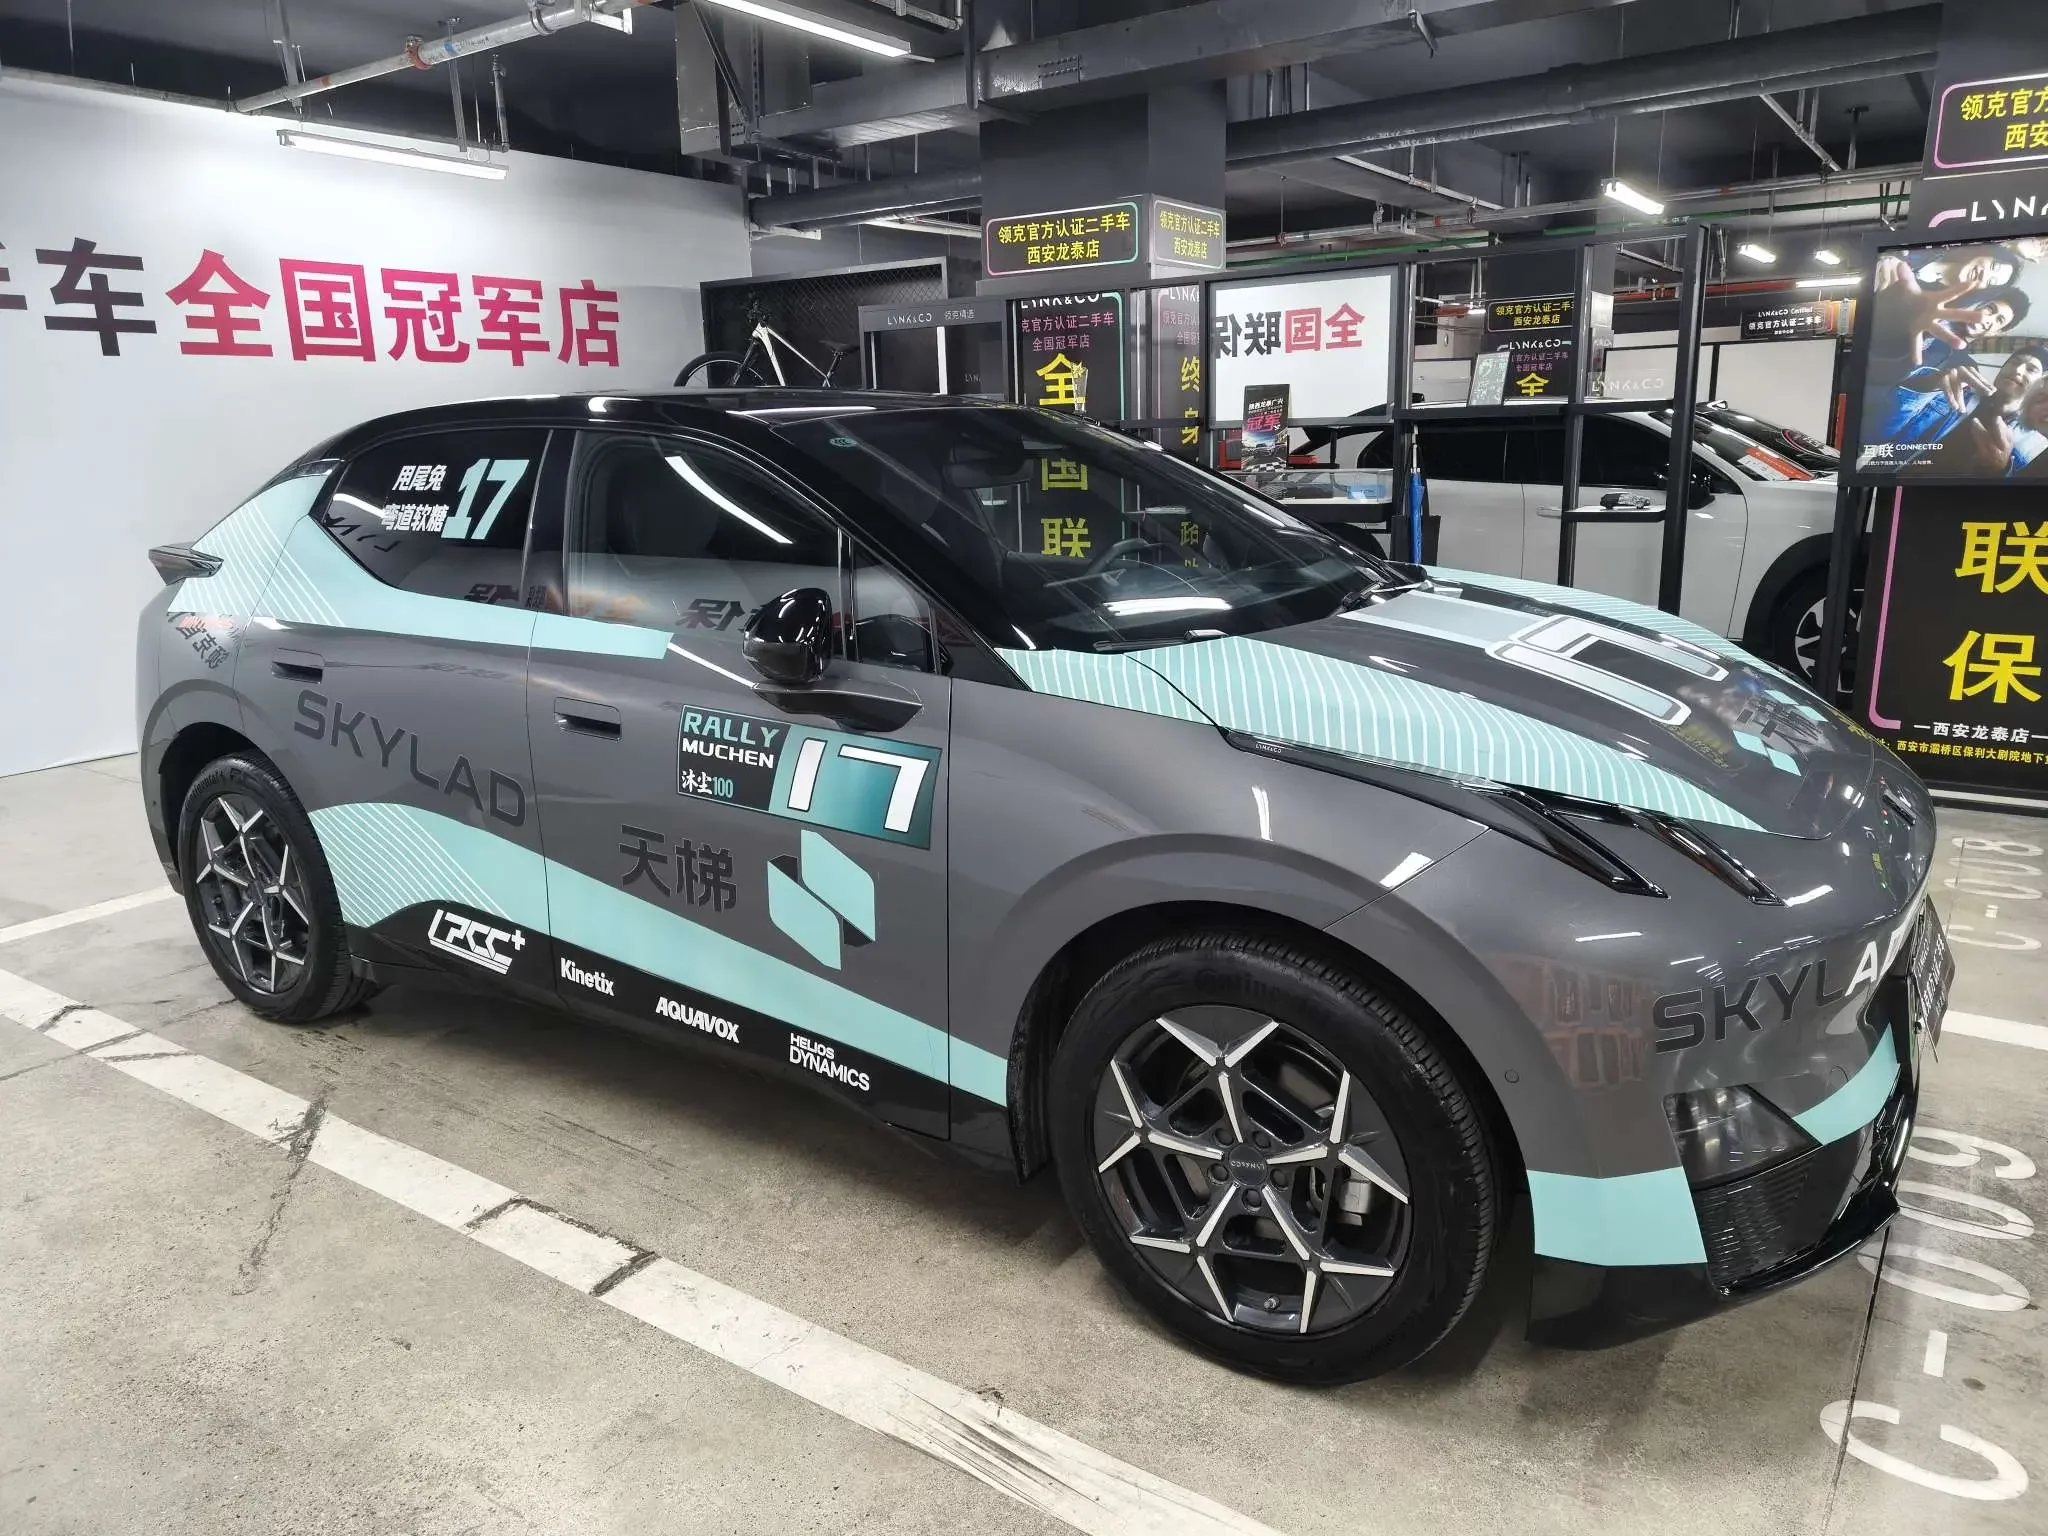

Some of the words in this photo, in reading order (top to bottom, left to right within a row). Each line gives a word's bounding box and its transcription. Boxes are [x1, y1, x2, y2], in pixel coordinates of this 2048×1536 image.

[998, 211, 1131, 244] 领克官方认证二手车
[1159, 210, 1221, 242] 领克官方认证二手车
[1027, 239, 1100, 265] 西安龙泰店
[1173, 236, 1209, 261] 西安龙泰店
[0, 237, 621, 367] 车全国冠军店
[1496, 301, 1574, 316] 领克官方认证二手
[887, 313, 932, 325] LYNK&CO
[1513, 314, 1560, 327] 西安龙泰店
[1033, 335, 1090, 352] 全国冠军店
[1509, 339, 1560, 350] LYNK&CO
[1862, 443, 1894, 458] 互联
[1895, 443, 1944, 451] CONNECTED
[391, 465, 448, 492] 甩尾兔
[440, 458, 530, 540] 17
[381, 504, 450, 532] 弯道软糖
[683, 711, 780, 748] RALLY
[293, 689, 527, 828] SKYLAD
[682, 737, 774, 769] MUCHEN
[787, 737, 932, 833] 17
[618, 823, 738, 914] 天梯
[560, 957, 615, 997] Kinetix
[655, 996, 741, 1045] AQUAVOX
[790, 1032, 835, 1060] HELIOS
[789, 1044, 870, 1092] DYNAMICS
